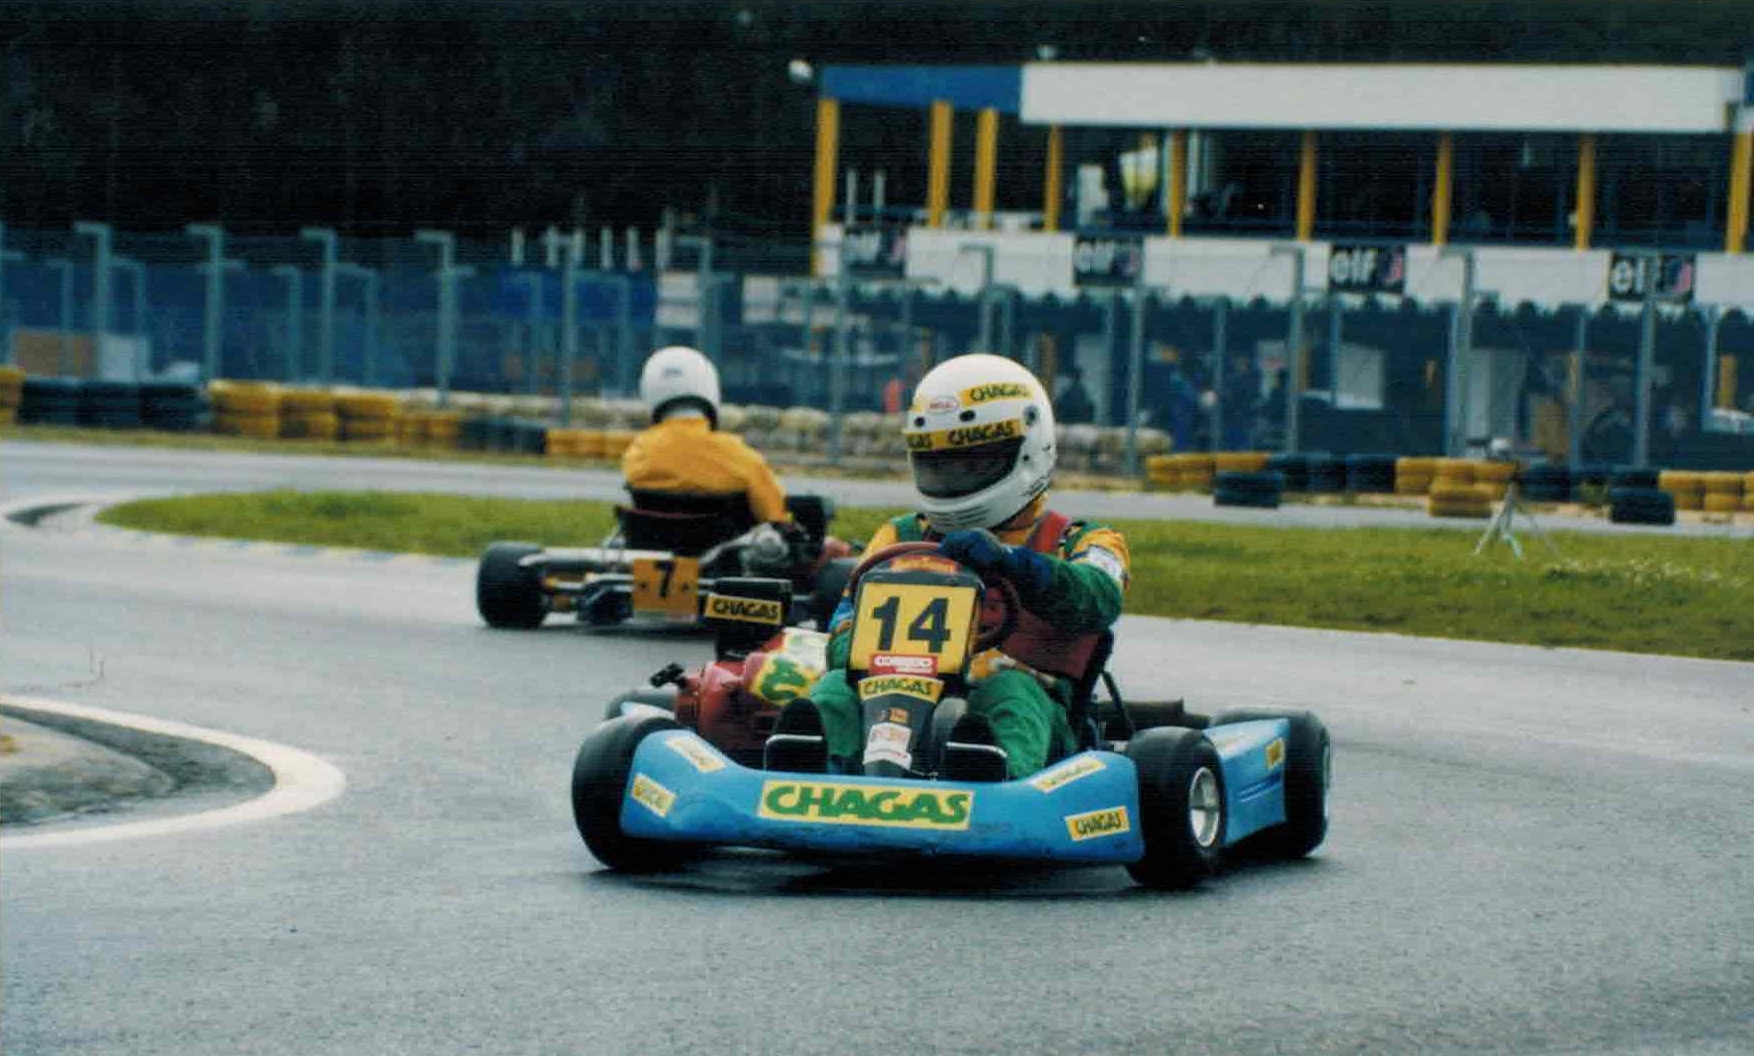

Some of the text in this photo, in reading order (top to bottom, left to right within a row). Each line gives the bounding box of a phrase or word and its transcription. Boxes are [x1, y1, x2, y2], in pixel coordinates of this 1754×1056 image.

[1330, 247, 1377, 283] elf
[947, 419, 1014, 445] CHAGAS
[653, 560, 678, 598] 7
[713, 597, 778, 619] CHAGAS
[871, 595, 951, 654] 14
[863, 676, 932, 695] CHAGAS
[765, 784, 969, 824] CHAGAS
[1076, 811, 1122, 835] CHAGAS
